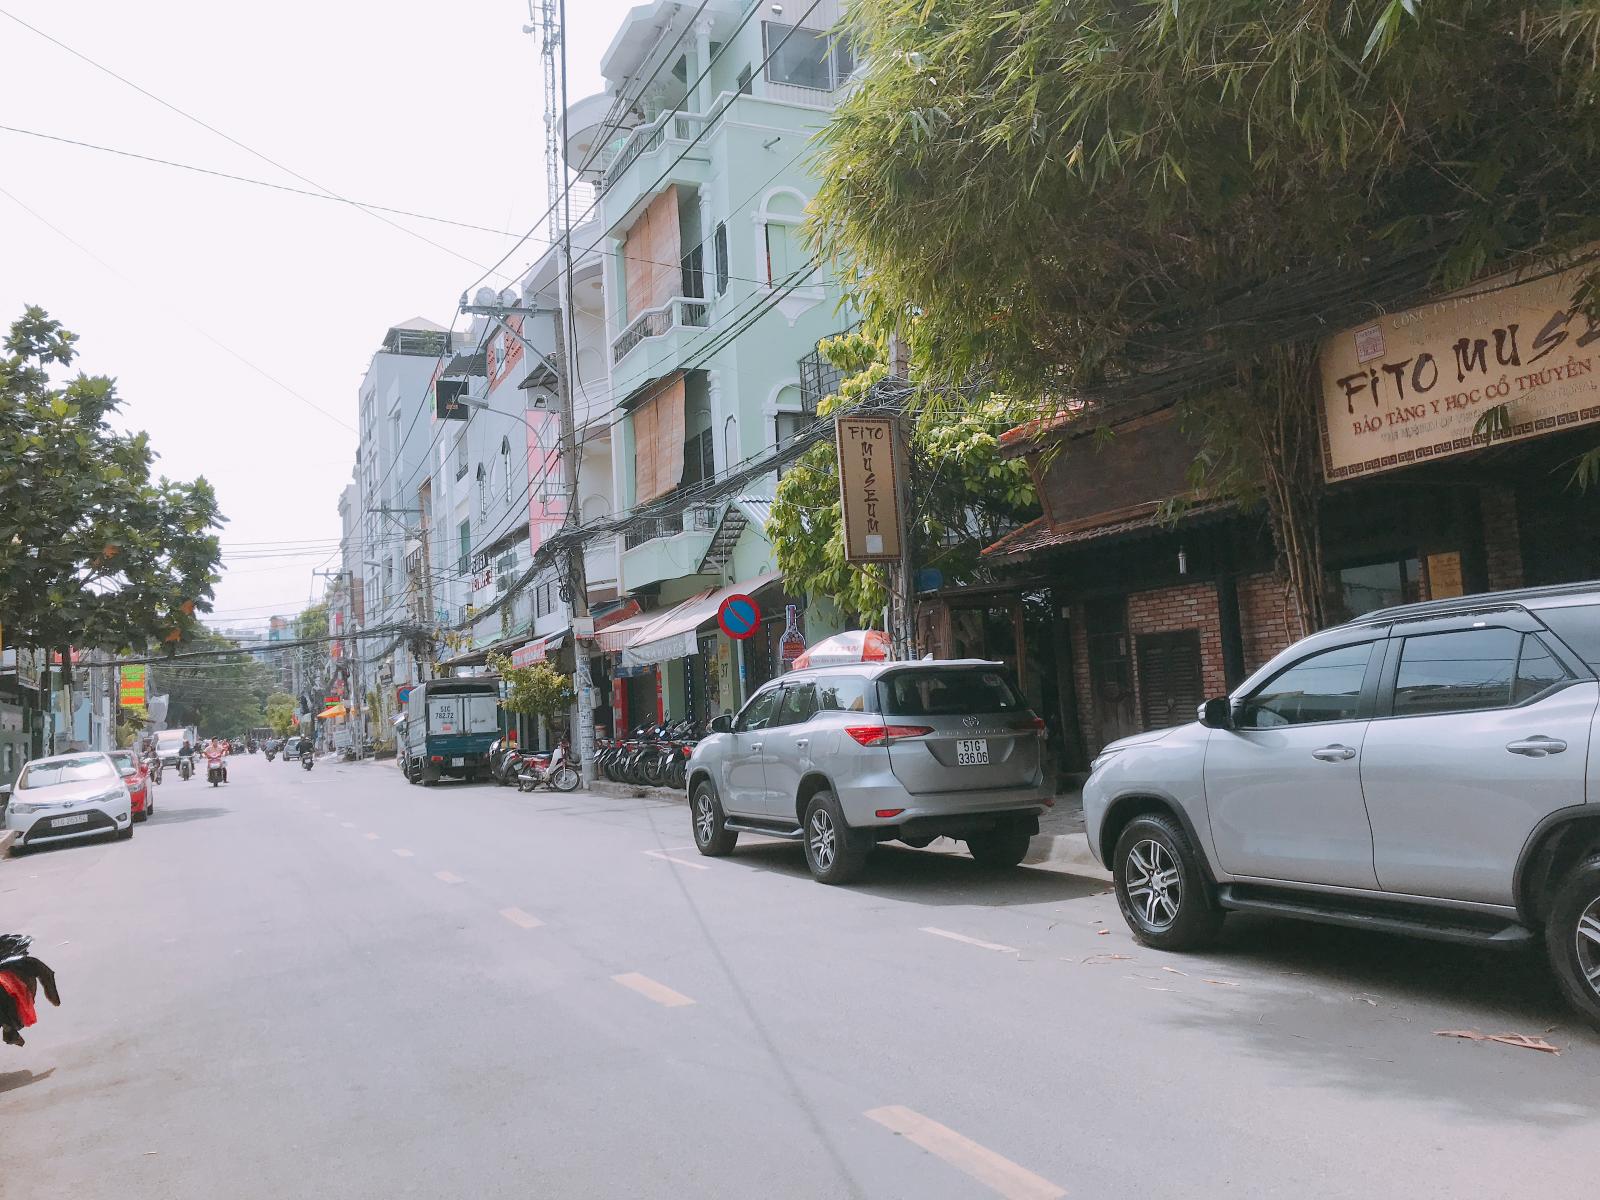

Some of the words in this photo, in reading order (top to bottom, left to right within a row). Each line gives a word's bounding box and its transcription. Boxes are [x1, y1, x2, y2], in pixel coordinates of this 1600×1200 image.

[1429, 399, 1440, 414] Y
[861, 441, 880, 533] MUSEUM
[720, 662, 729, 678] 37
[963, 740, 981, 751] 51G
[958, 752, 988, 764] 336.06
